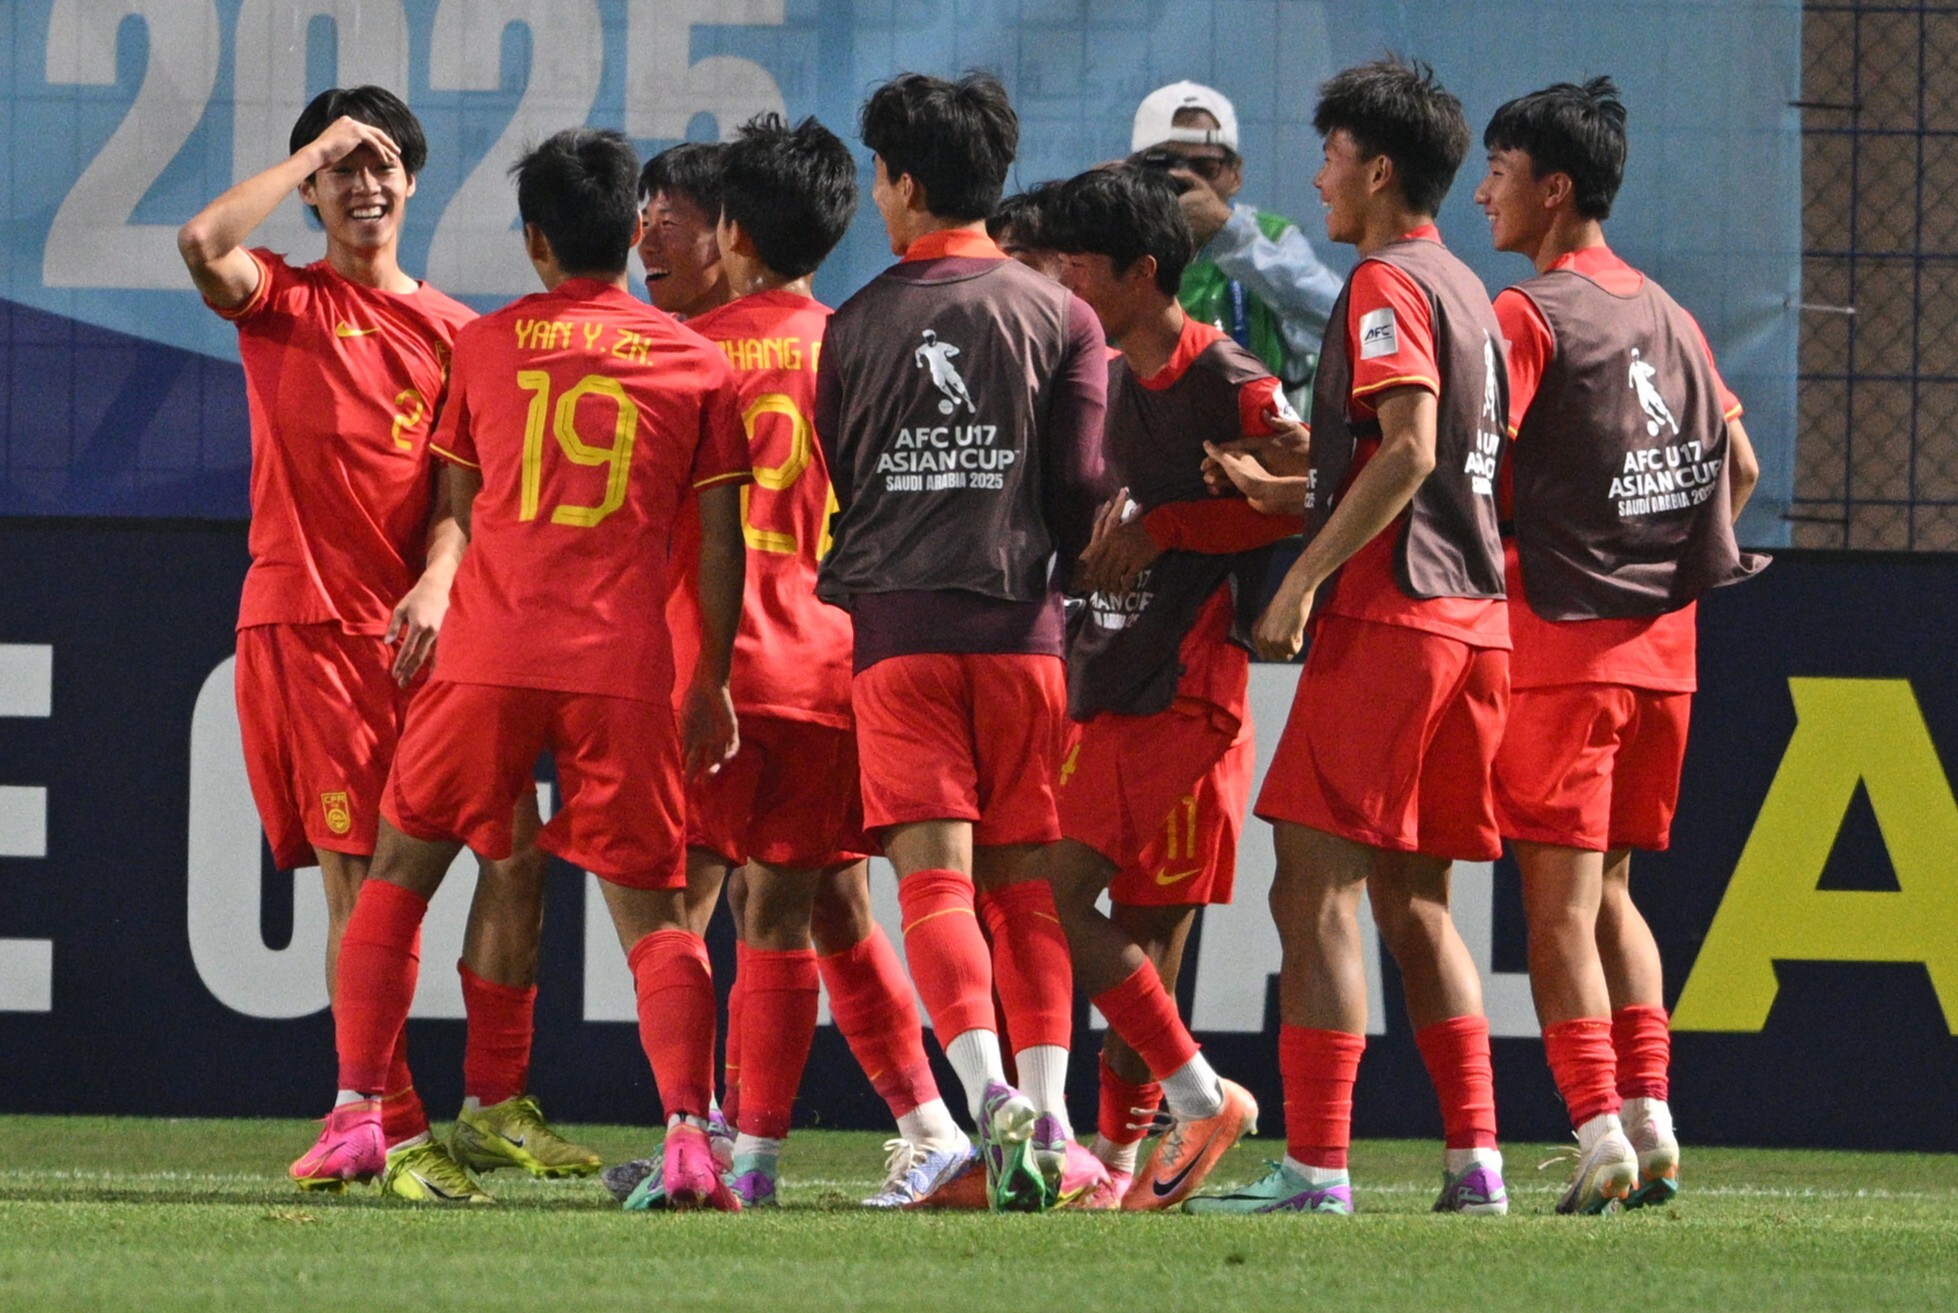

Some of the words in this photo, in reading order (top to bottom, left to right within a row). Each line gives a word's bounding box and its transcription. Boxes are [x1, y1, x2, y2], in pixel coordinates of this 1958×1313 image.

[515, 319, 573, 349] YAN
[1365, 324, 1392, 341] AFC
[717, 337, 801, 370] HANG
[392, 389, 423, 450] 2
[517, 371, 638, 528] 19
[894, 427, 949, 449] AFC
[954, 424, 997, 446] U17
[876, 450, 957, 473] ASIAN
[959, 448, 1015, 470] CUP
[1623, 448, 1663, 474] AFC
[1665, 440, 1701, 468] U17
[886, 475, 923, 491] SAUDI
[926, 472, 966, 490] ARABIA
[969, 472, 1004, 489] 2025
[1608, 470, 1675, 499] ASIAN
[1675, 459, 1722, 488] CUP
[1618, 498, 1650, 517] SAUDI
[1651, 491, 1691, 513] ARABIA
[1165, 796, 1197, 859] 11
